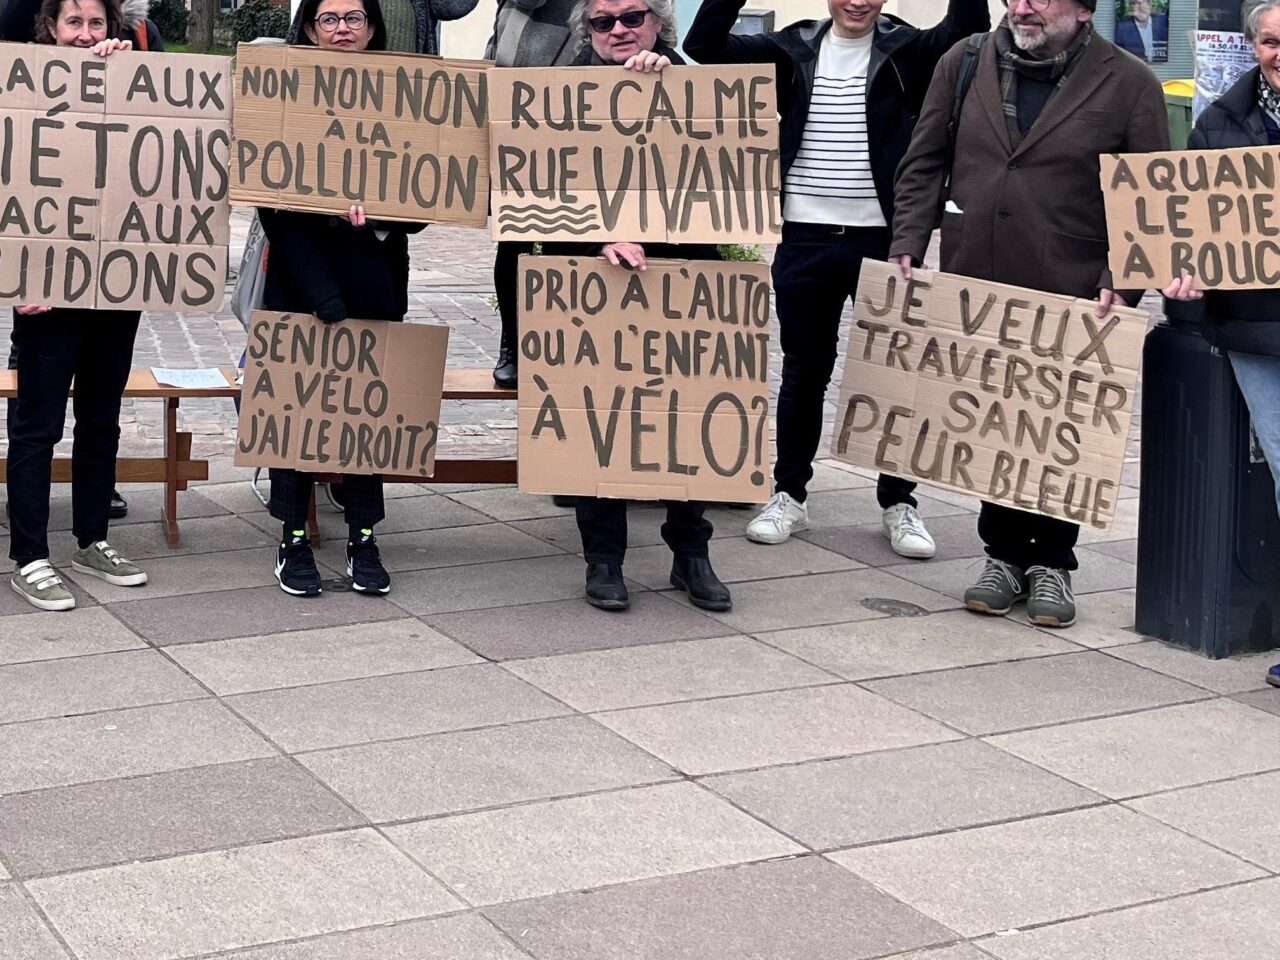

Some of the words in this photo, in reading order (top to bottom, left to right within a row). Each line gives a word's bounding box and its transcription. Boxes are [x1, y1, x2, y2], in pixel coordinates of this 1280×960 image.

[125, 62, 224, 111] AUX
[241, 65, 299, 102] NON
[313, 65, 384, 112] NON
[395, 65, 488, 128] NON
[511, 80, 602, 133] RUE
[610, 76, 774, 139] CALME
[324, 109, 345, 140] À
[355, 121, 391, 148] LA
[498, 143, 578, 203] RUE
[1146, 151, 1280, 193] QUAN
[118, 200, 215, 247] AUX
[1135, 195, 1194, 238] LE
[1208, 193, 1280, 236] PIE
[1122, 230, 1154, 280] À
[662, 267, 770, 328] L'AUTO
[863, 274, 931, 327] JE
[959, 287, 1120, 375] VEUX
[249, 314, 380, 376] SÉNIOR
[521, 328, 566, 367] OU
[571, 316, 600, 366] À
[614, 324, 770, 383] L'ENFANT
[251, 360, 275, 400] À
[295, 368, 388, 418] VÉLO
[856, 320, 1127, 434] TRAVERSER
[300, 417, 331, 463] LE
[531, 374, 567, 441] À
[583, 378, 769, 486] VÉLO?
[943, 390, 1081, 466] SANS
[836, 393, 975, 490] PEUR
[988, 450, 1114, 529] BLEUE
